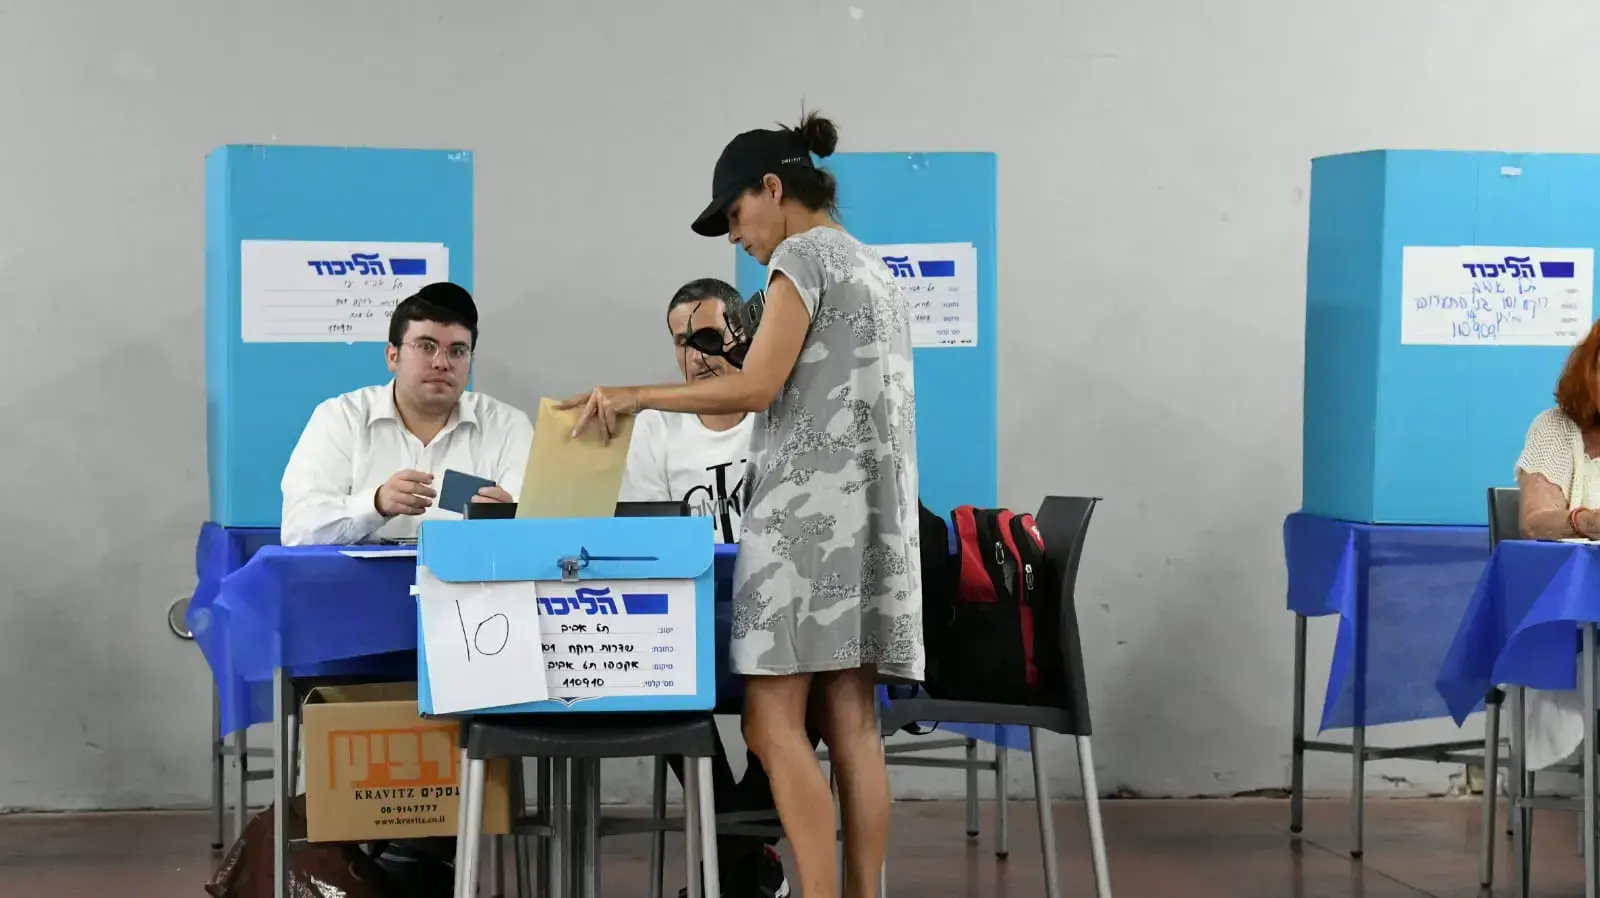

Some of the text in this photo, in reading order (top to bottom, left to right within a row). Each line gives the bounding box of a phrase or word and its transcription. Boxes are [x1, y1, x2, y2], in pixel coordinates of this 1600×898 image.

[307, 253, 386, 276] הליכוד
[1462, 256, 1536, 278] הליכוד
[455, 599, 510, 662] 10
[561, 624, 610, 634] תל אביב
[568, 644, 594, 656] רוקח
[600, 643, 634, 653] שדרות
[562, 677, 605, 688] 110910
[355, 788, 415, 800] KRAVITZ
[374, 815, 446, 826] www.kravitz.co.il
